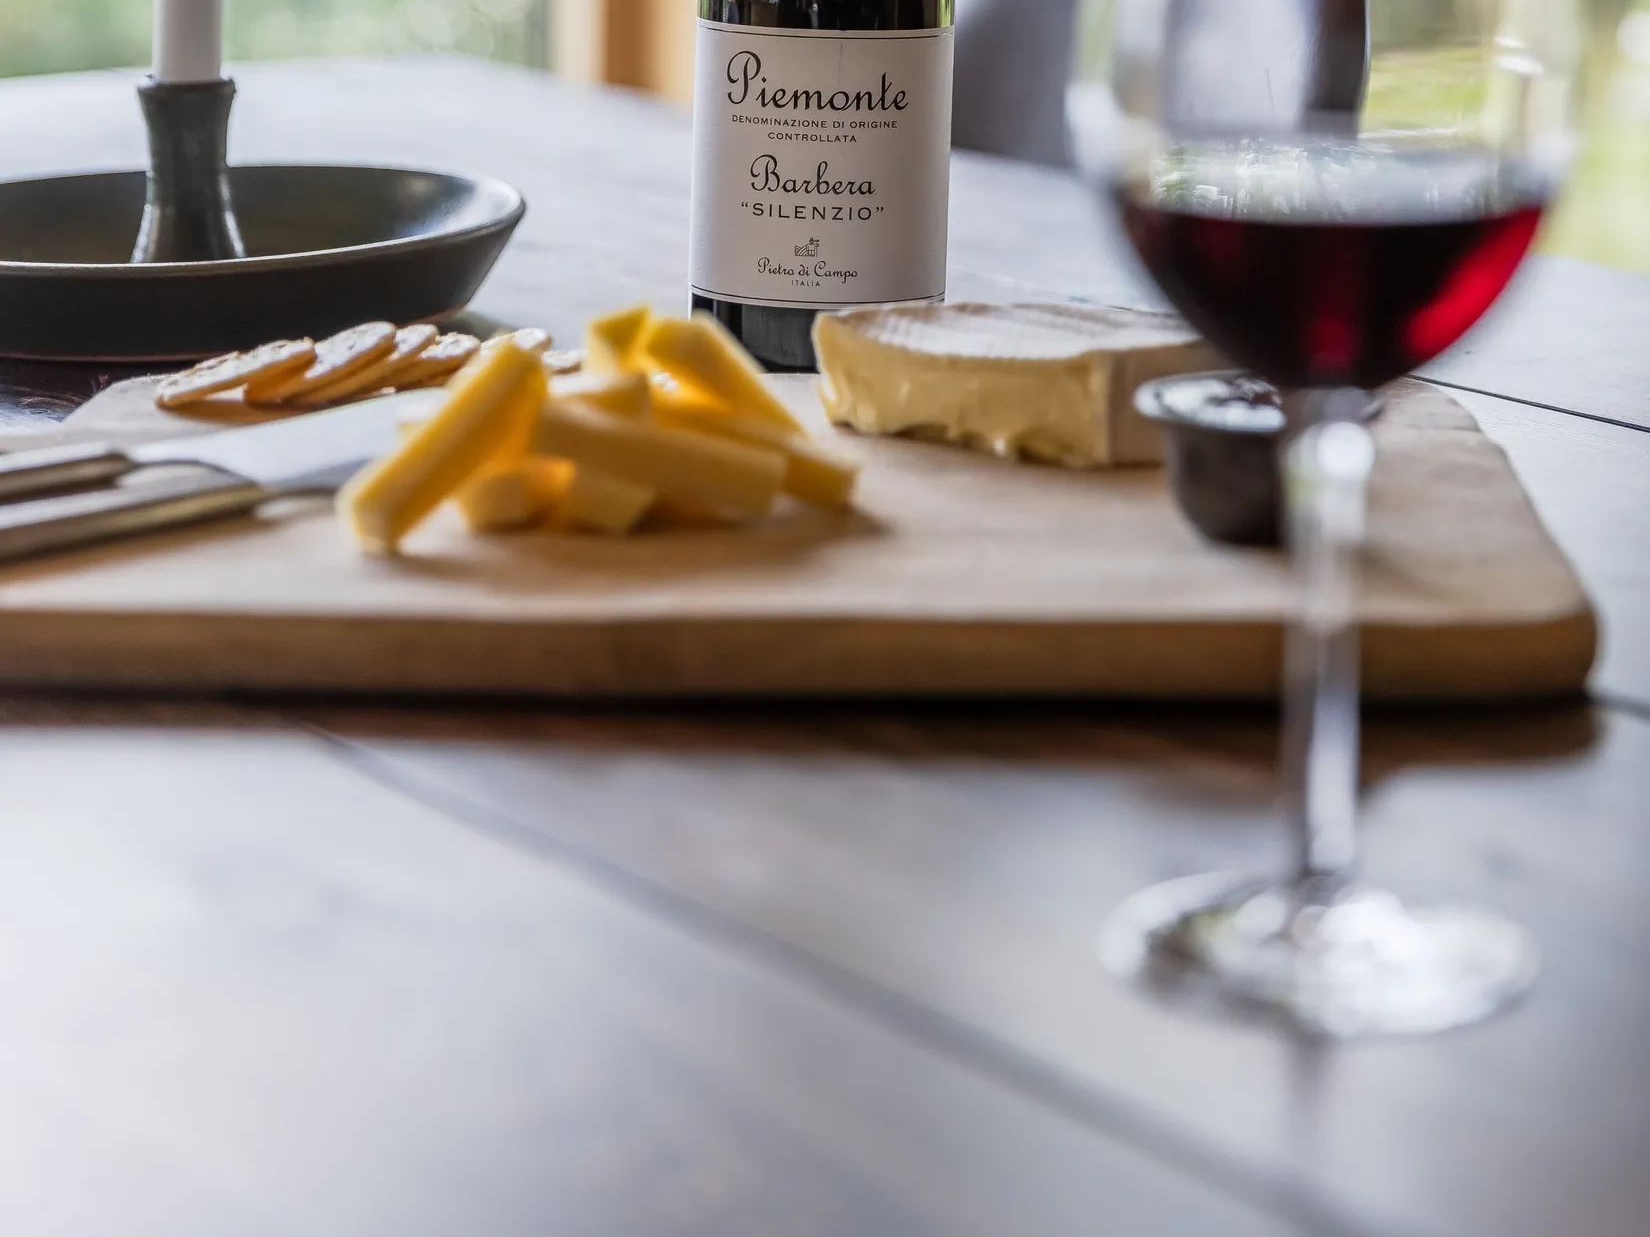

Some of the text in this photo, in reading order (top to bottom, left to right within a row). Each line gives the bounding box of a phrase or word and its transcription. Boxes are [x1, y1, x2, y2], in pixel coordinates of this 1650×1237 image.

[726, 50, 909, 112] Piemonte
[731, 114, 898, 129] DENOMINAZIONE DI ORIGINE
[767, 131, 857, 143] CONTROLLATA
[750, 154, 876, 195] Barbera
[741, 201, 884, 221] “SILENZIO”
[757, 256, 858, 284] Pietro di Campo
[791, 279, 820, 287] ITALIA
